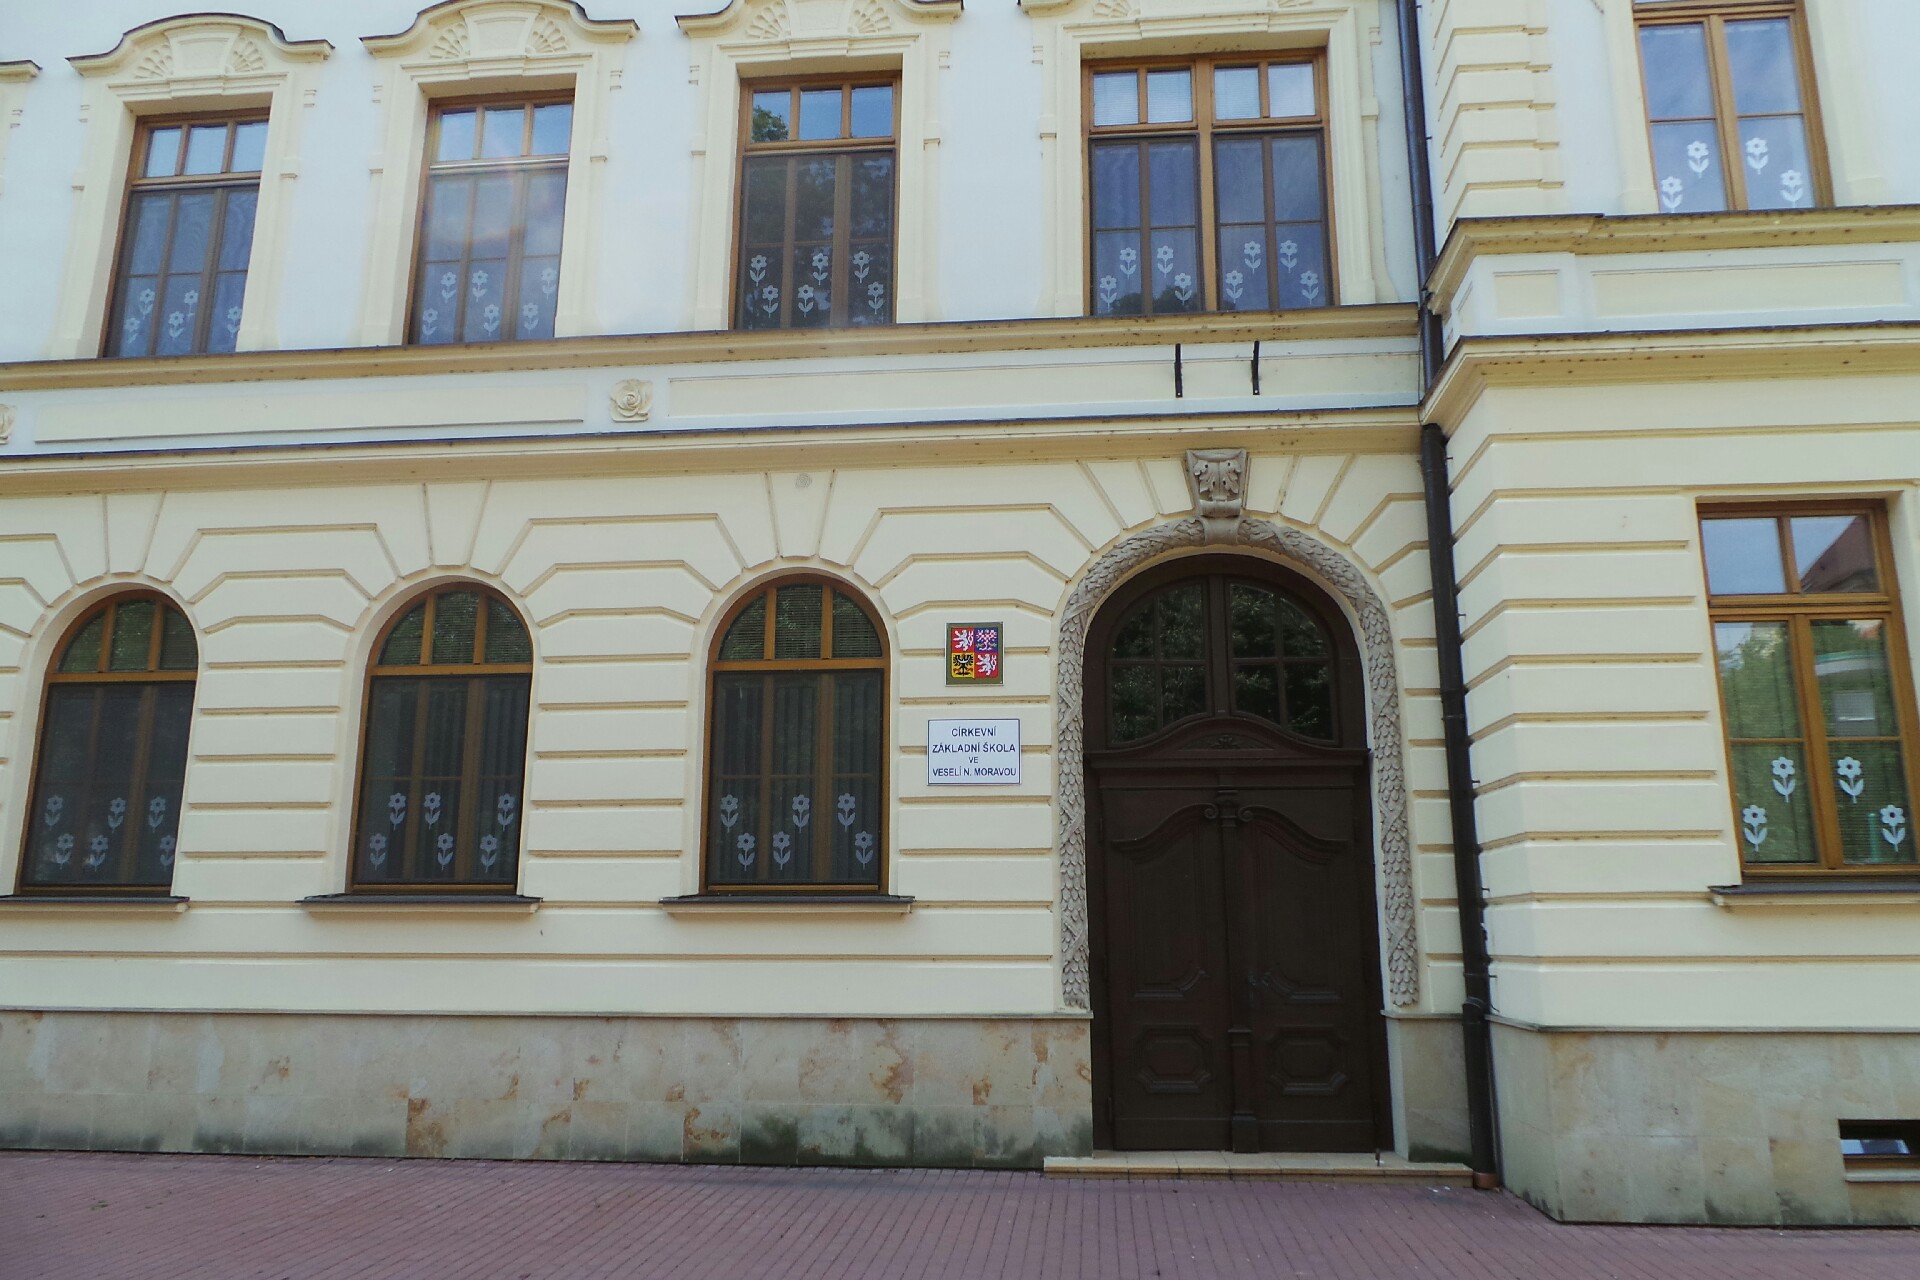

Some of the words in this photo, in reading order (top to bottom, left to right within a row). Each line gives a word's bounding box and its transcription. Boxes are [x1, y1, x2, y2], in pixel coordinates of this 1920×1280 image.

[951, 726, 997, 737] CÍRKEVNÍ
[932, 742, 980, 753] ZÁKLADNÍ
[982, 742, 1016, 753] ŠKOLA
[968, 756, 979, 764] VE
[932, 766, 962, 776] VESELÍ
[963, 768, 972, 777] N.
[974, 767, 1017, 776] MORAVOU
